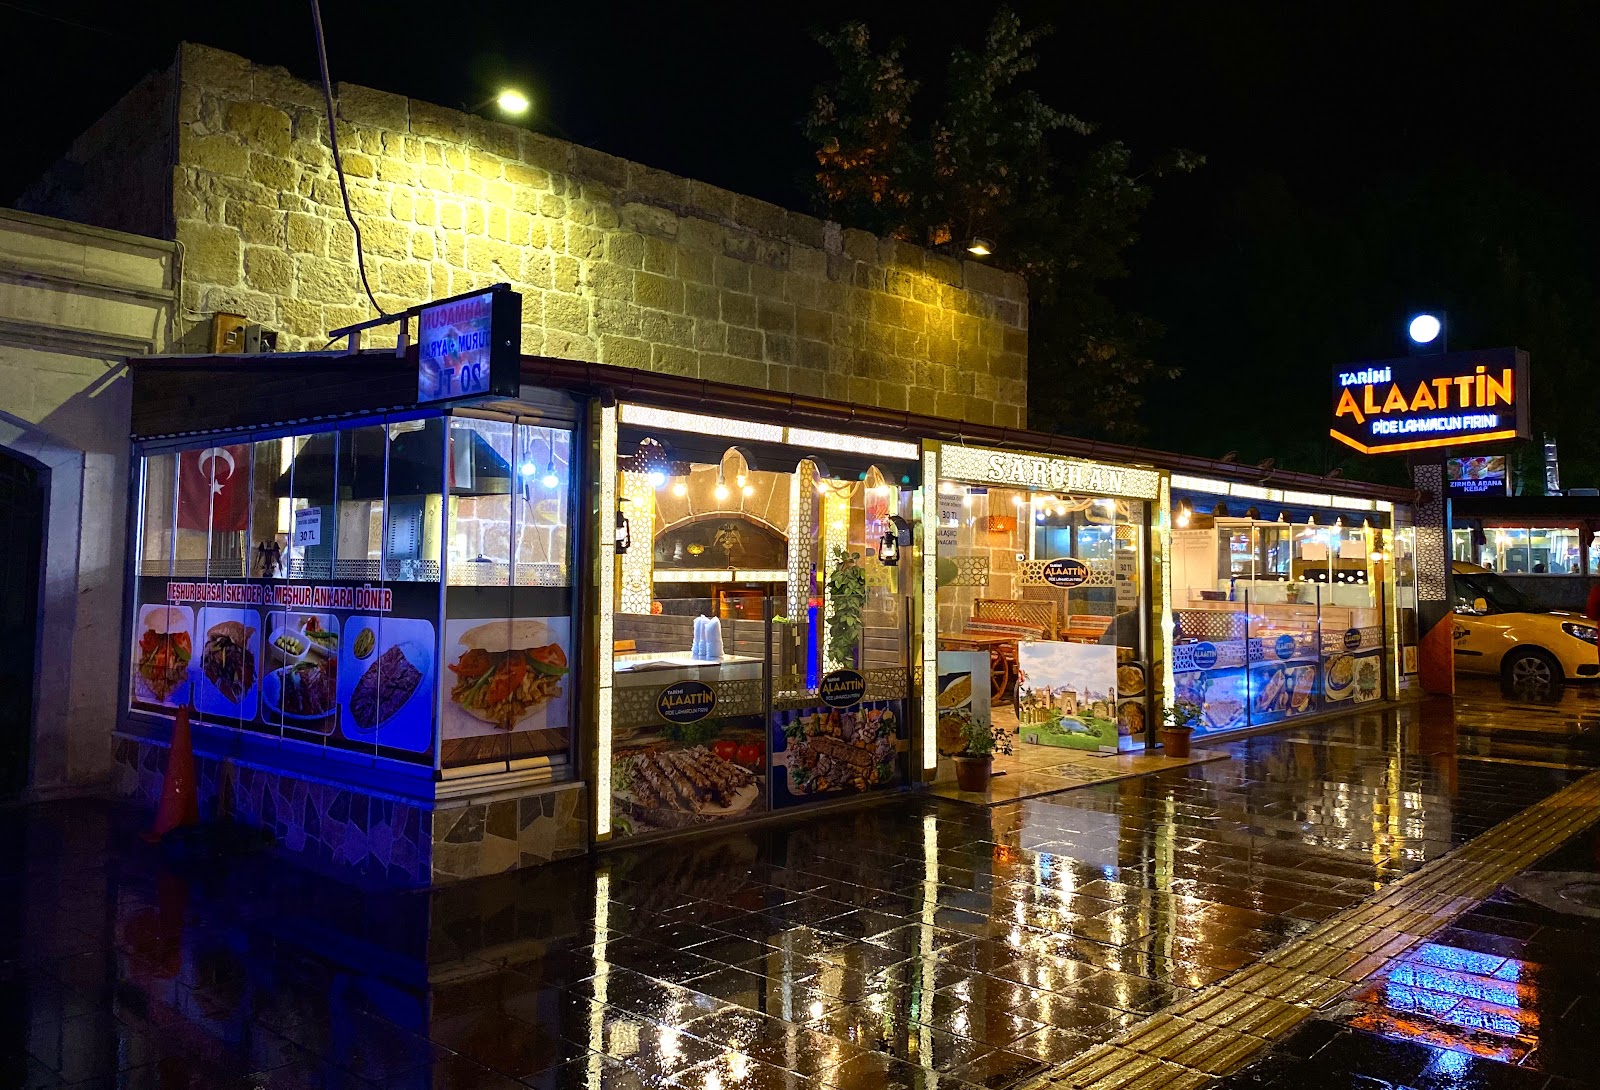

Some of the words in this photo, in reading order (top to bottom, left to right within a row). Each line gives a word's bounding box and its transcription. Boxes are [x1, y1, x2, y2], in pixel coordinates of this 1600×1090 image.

[1339, 366, 1391, 386] TARİHİ
[1335, 365, 1512, 424] ALAATTİN
[1372, 419, 1399, 434] PİDE
[1399, 414, 1461, 433] LAHMACUN
[1463, 413, 1498, 430] FIRINI
[942, 510, 950, 519] 30
[300, 531, 308, 542] 30
[308, 530, 315, 540] TL
[1045, 566, 1086, 577] ALAATTİN
[1120, 564, 1126, 572] 30
[196, 582, 222, 602] BURSA
[222, 580, 262, 605] İSKENDER
[264, 584, 273, 606] &
[274, 584, 312, 611] MEŞHUR
[312, 586, 354, 610] ANKARA
[354, 584, 393, 612] DÖNER
[822, 678, 864, 695] ALAATTİN
[660, 690, 714, 710] ALAATTİN
